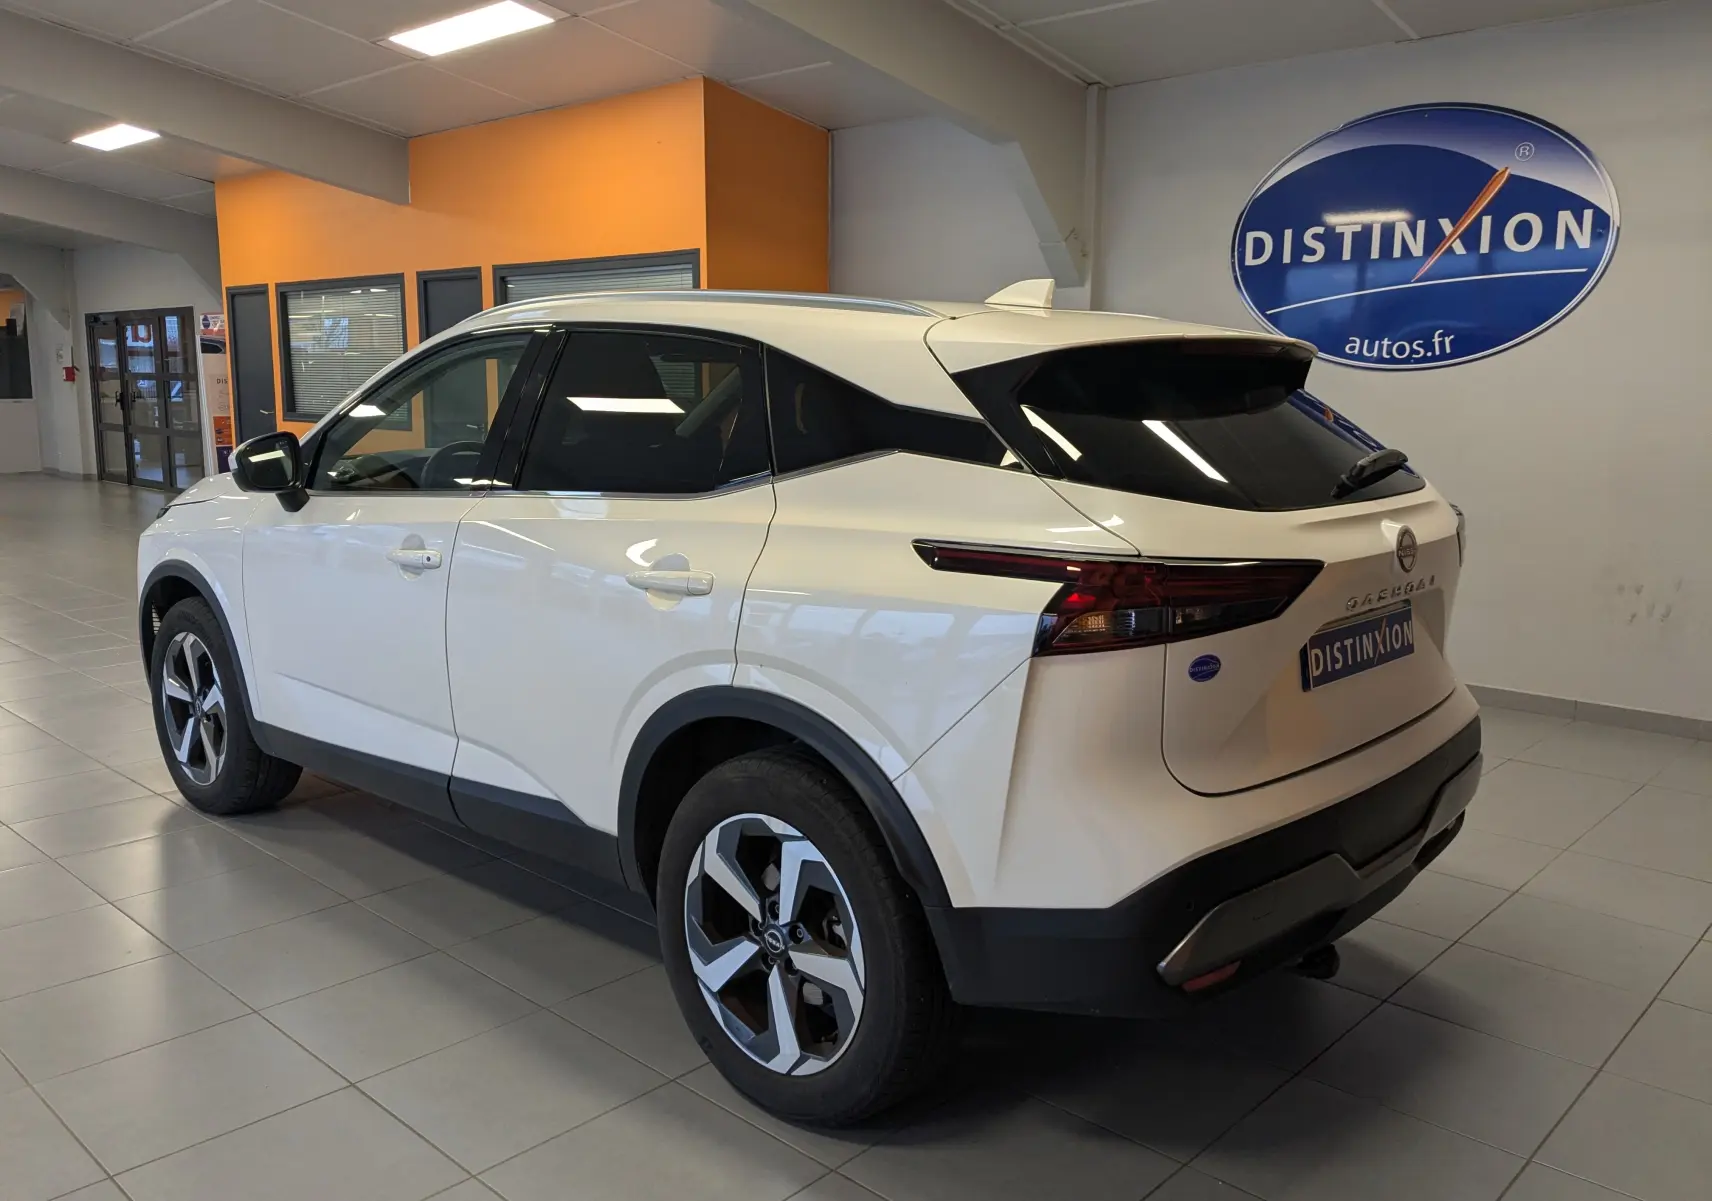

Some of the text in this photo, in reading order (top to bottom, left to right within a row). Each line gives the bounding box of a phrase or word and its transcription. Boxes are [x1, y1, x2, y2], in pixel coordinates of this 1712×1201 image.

[1244, 207, 1594, 267] DISTINXION
[1344, 328, 1456, 360] autos.fr
[1310, 620, 1414, 677] DISTINXION
